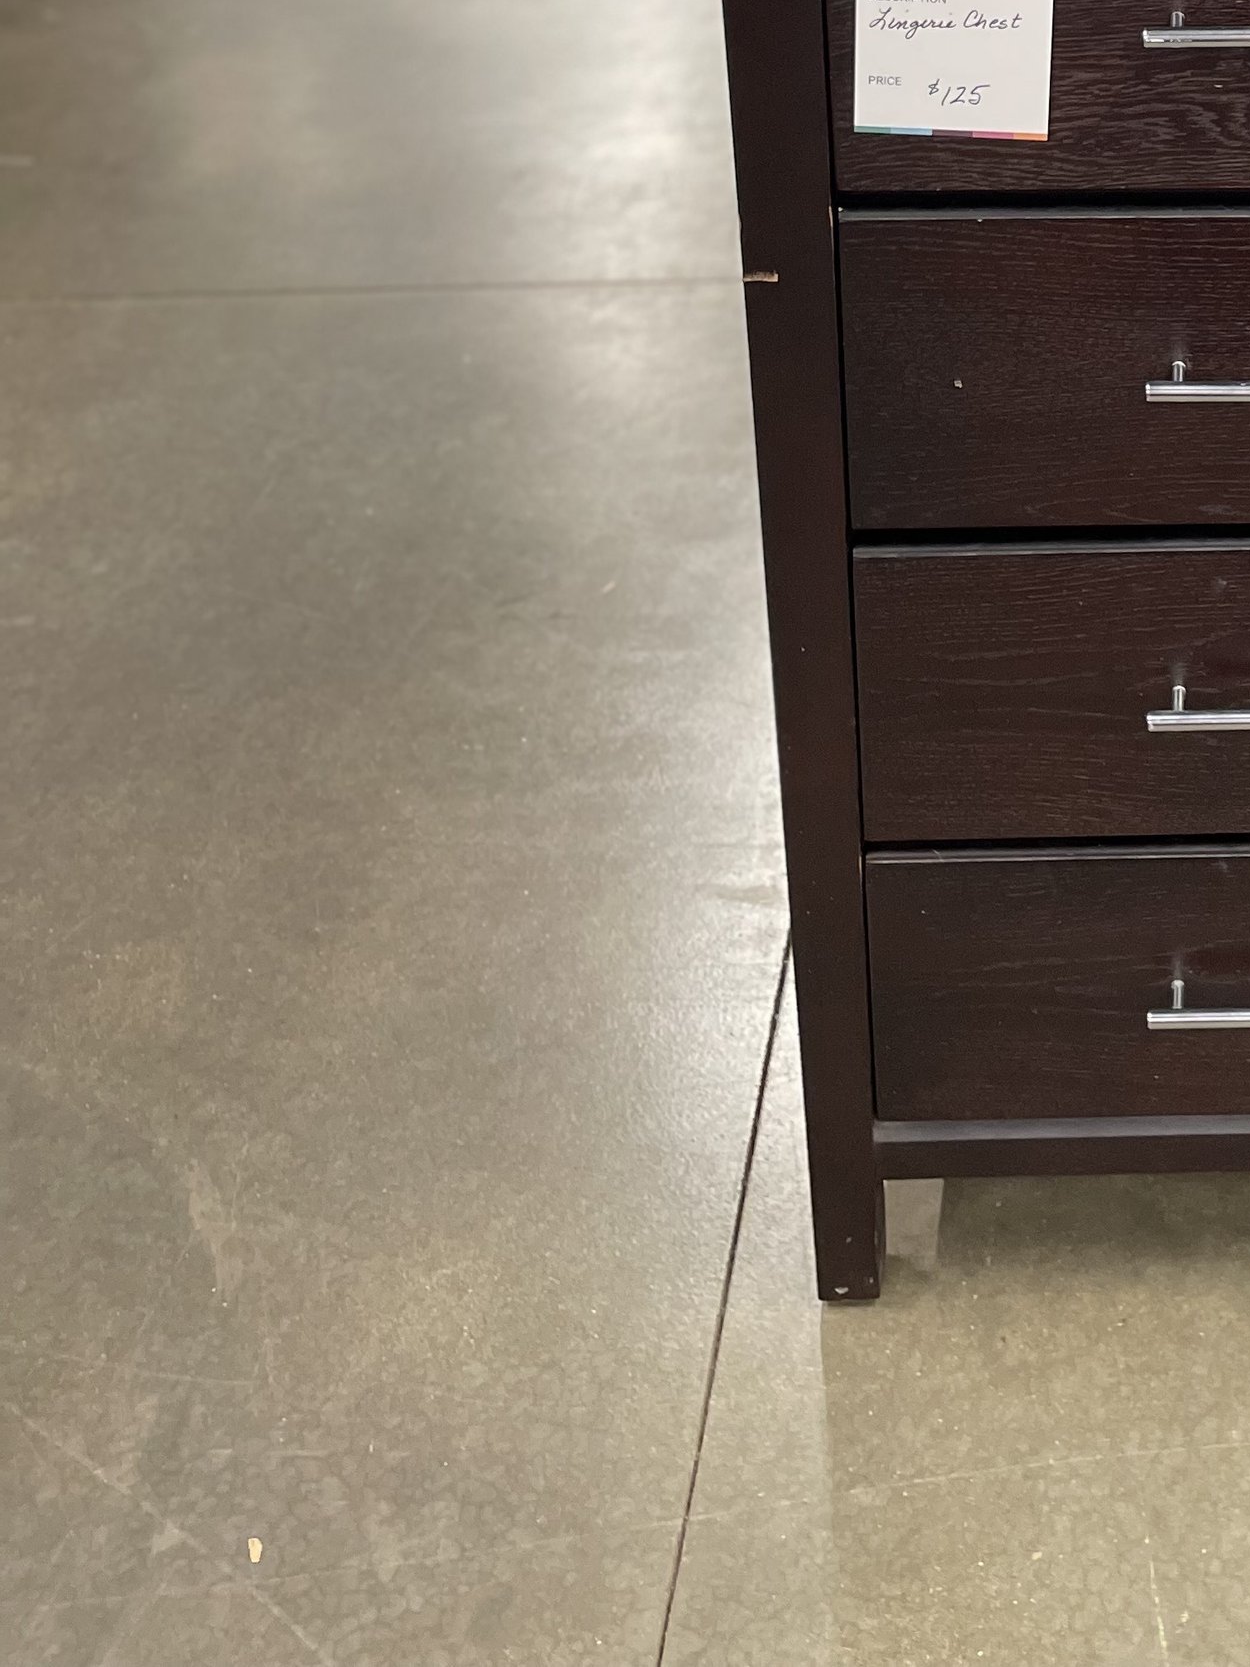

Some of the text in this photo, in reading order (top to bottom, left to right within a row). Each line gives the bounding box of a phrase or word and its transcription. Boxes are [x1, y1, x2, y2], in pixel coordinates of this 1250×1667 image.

[963, 10, 1023, 30] Chest
[869, 76, 990, 106] PRICE $125
